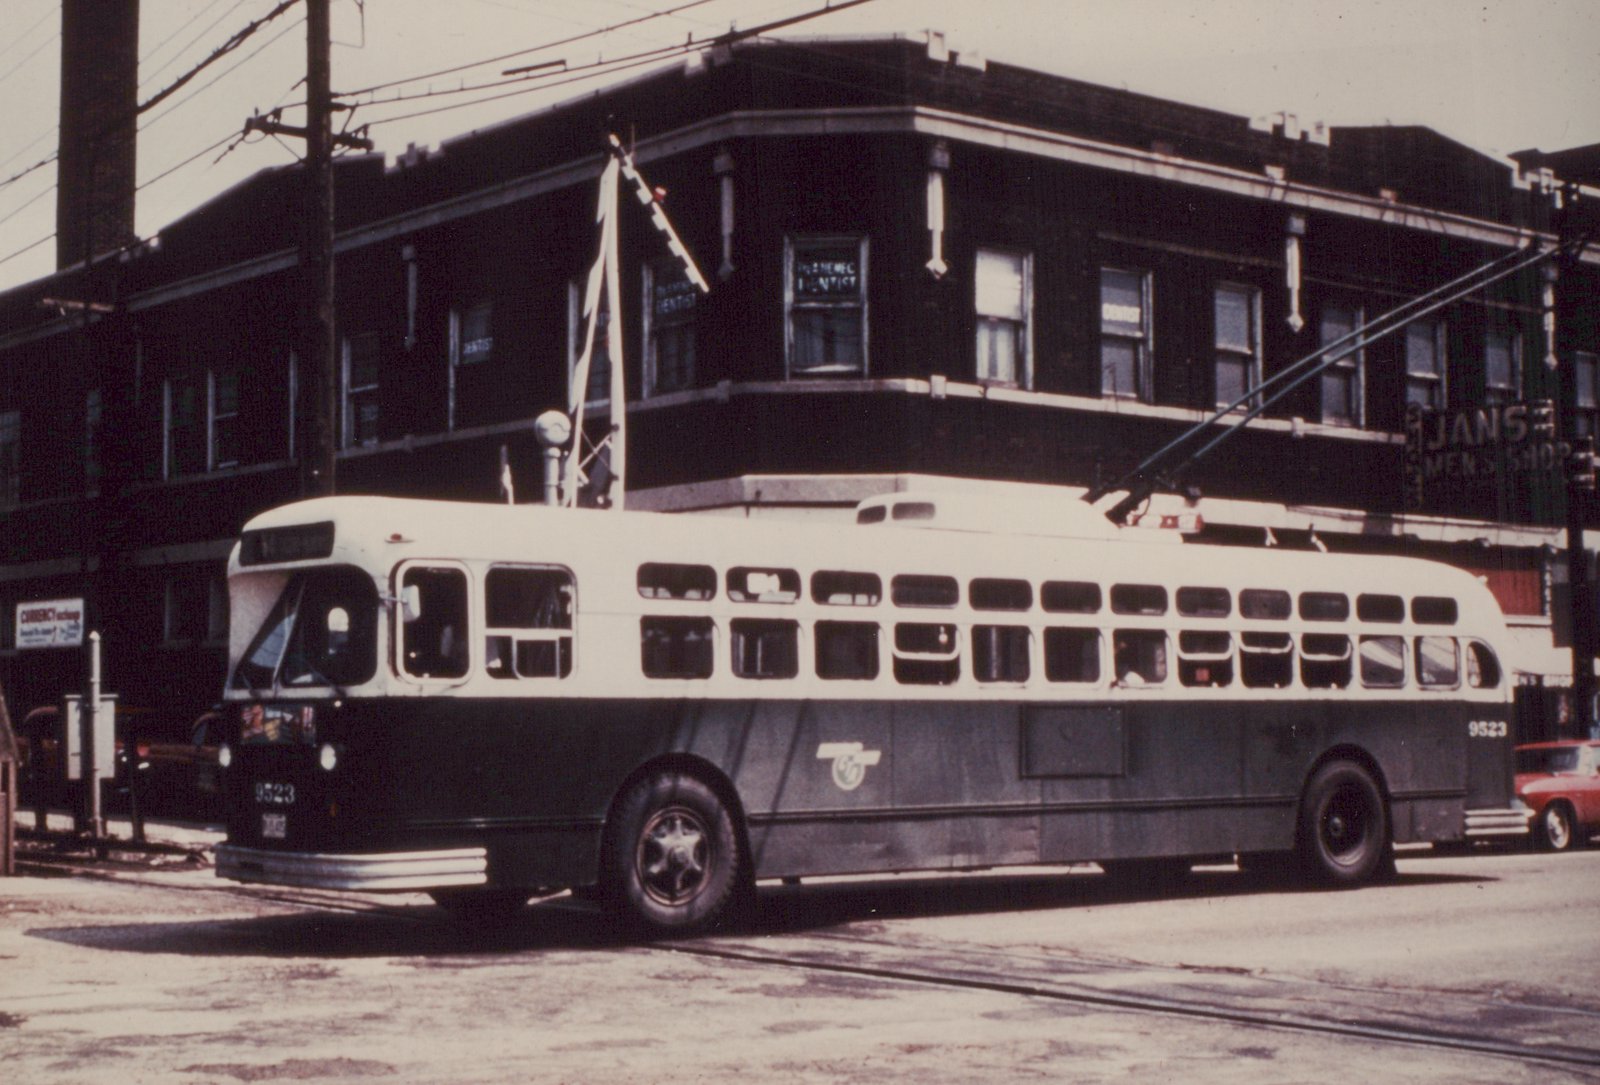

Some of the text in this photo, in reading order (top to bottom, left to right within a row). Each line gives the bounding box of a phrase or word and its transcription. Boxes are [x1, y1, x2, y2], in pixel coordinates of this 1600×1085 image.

[1427, 405, 1528, 450] JANS
[1468, 720, 1508, 737] 9523
[255, 782, 296, 804] 9523
